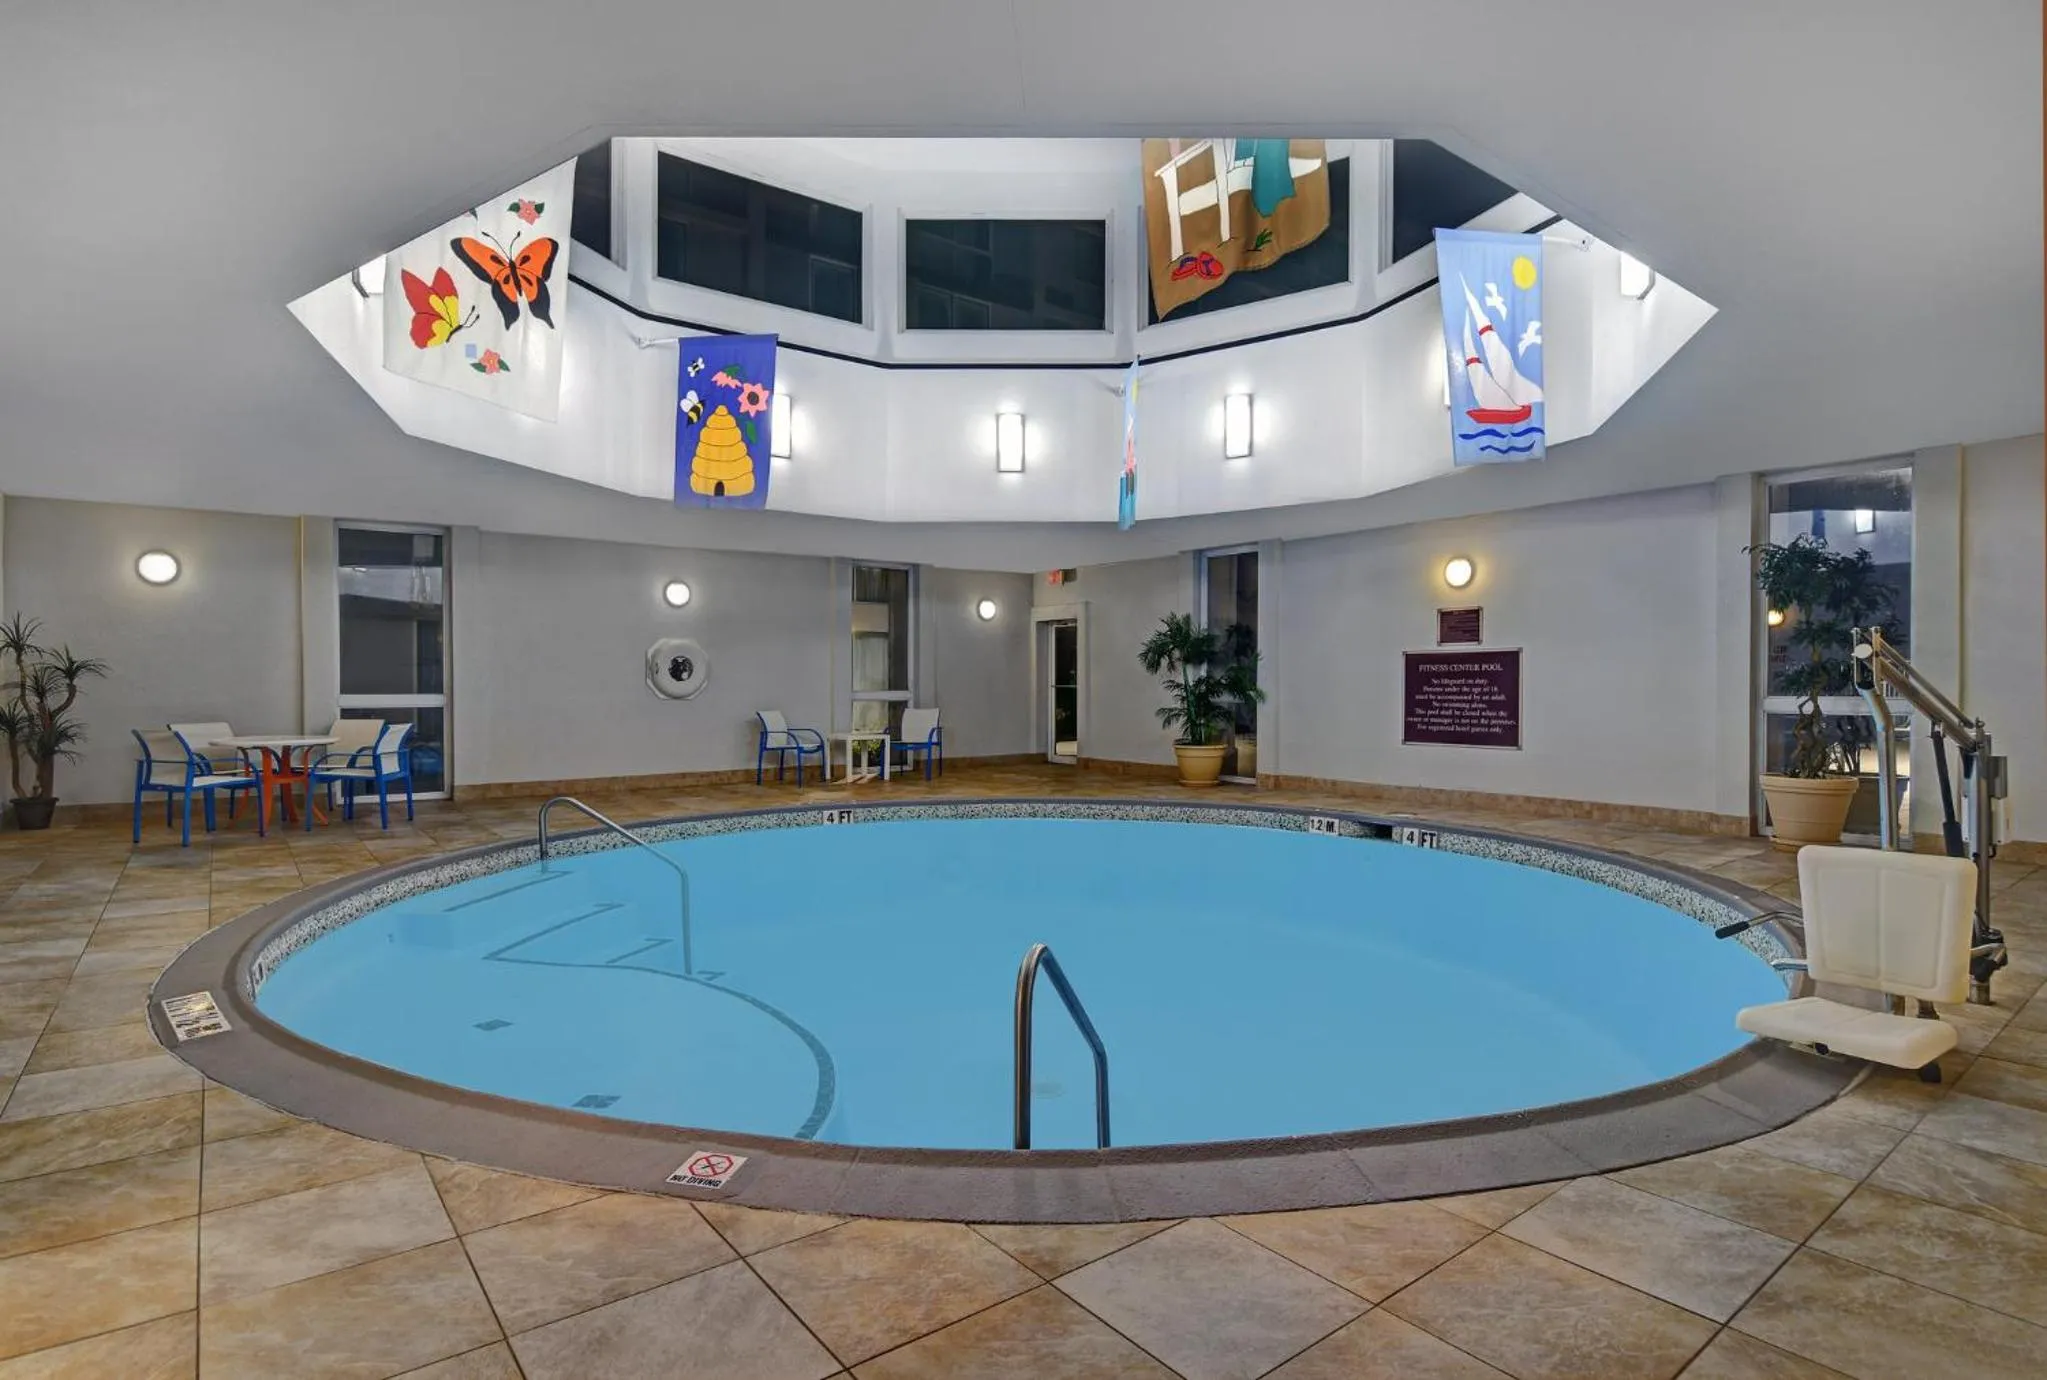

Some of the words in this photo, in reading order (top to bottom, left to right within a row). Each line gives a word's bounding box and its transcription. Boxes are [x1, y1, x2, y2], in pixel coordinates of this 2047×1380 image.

[1418, 664, 1448, 672] FITNESS
[1449, 663, 1480, 672] CENTER
[1481, 662, 1504, 672] POOL
[826, 812, 835, 823] 4
[838, 810, 852, 824] FT
[1406, 831, 1415, 844] 4
[1421, 832, 1437, 848] FT
[670, 1174, 686, 1182] NO
[687, 1176, 722, 1187] DIVING
